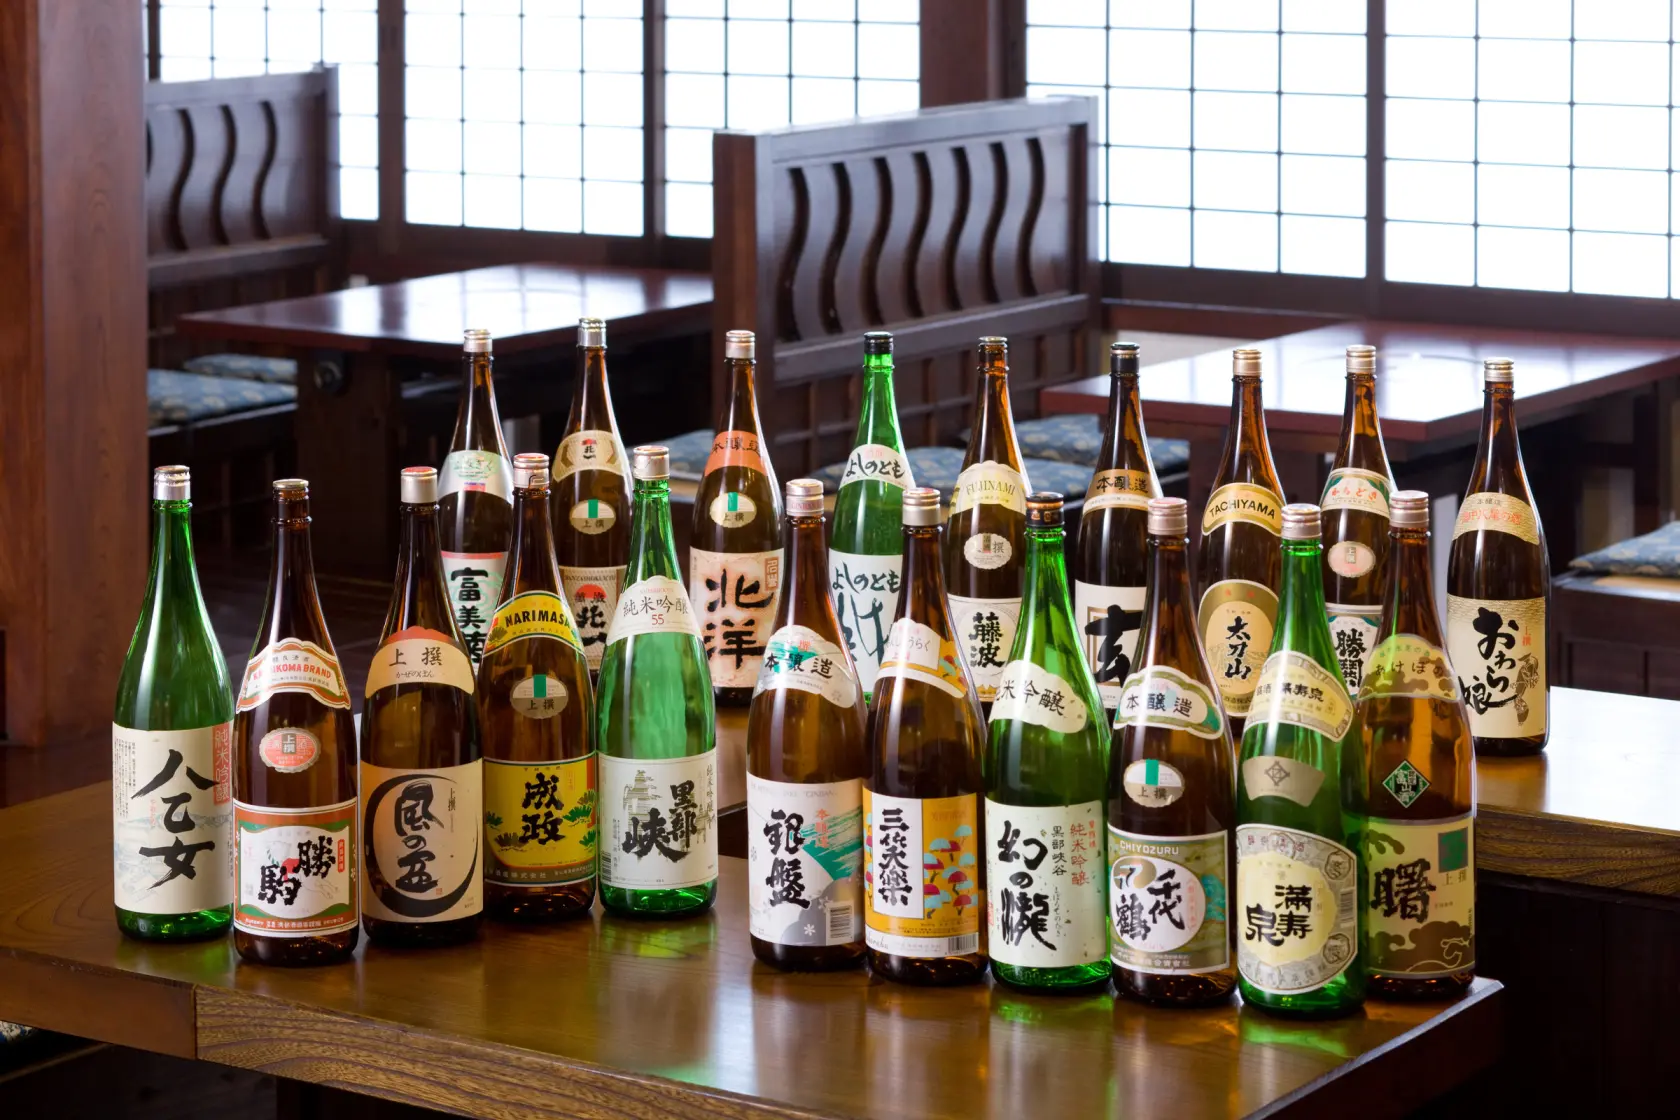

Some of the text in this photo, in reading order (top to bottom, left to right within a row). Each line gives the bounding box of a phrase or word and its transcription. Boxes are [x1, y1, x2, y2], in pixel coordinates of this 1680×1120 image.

[845, 452, 906, 480] よしのとも
[965, 480, 1016, 496] FUJINAMI
[1209, 499, 1276, 520] TACHIYAMA
[623, 595, 689, 617] 純米吟醸
[832, 560, 901, 594] よしのとも
[504, 609, 571, 629] NARIMASA
[651, 613, 665, 625] 55
[703, 568, 775, 670] 北洋
[968, 611, 1006, 669] 藤波
[1225, 615, 1251, 680] 太刀山
[303, 664, 332, 679] BRAND
[388, 646, 444, 667] 上撰
[1375, 660, 1445, 678] あけぼの
[1458, 606, 1519, 716] おわら娘
[528, 699, 555, 710] 上撰
[1125, 692, 1193, 718] 本醸造
[214, 727, 232, 806] 純米吟醸
[131, 748, 221, 891] 八乙女
[393, 779, 445, 894] 風の盆
[518, 771, 566, 846] 成政
[257, 834, 337, 907] 勝駒
[763, 807, 811, 910] 銀盤
[1051, 825, 1068, 877] 黒部峡谷
[1069, 823, 1091, 887] 純米吟醸
[1119, 839, 1180, 856] CHIYOZURU
[997, 819, 1058, 952] 幻の瀧
[1115, 868, 1186, 941] 千代鶴
[1370, 857, 1437, 924] 曙
[1244, 884, 1314, 947] 満寿泉
